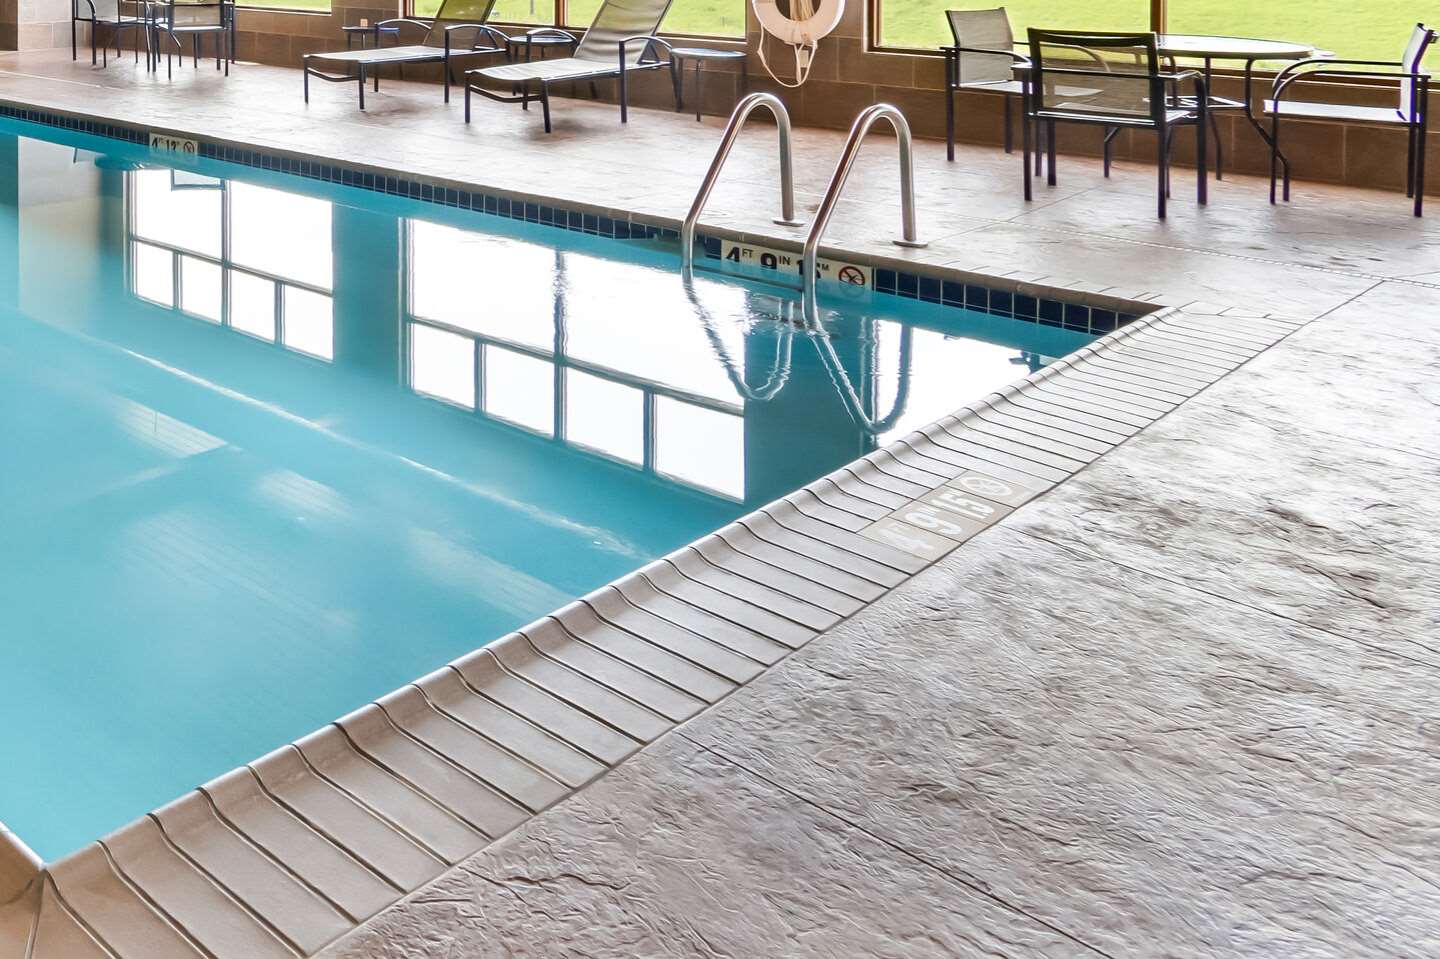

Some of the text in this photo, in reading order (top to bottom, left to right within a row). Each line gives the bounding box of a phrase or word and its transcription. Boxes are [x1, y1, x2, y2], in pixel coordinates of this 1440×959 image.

[726, 246, 740, 262] 4
[742, 248, 753, 258] FT
[778, 255, 791, 266] IN
[821, 264, 830, 272] M
